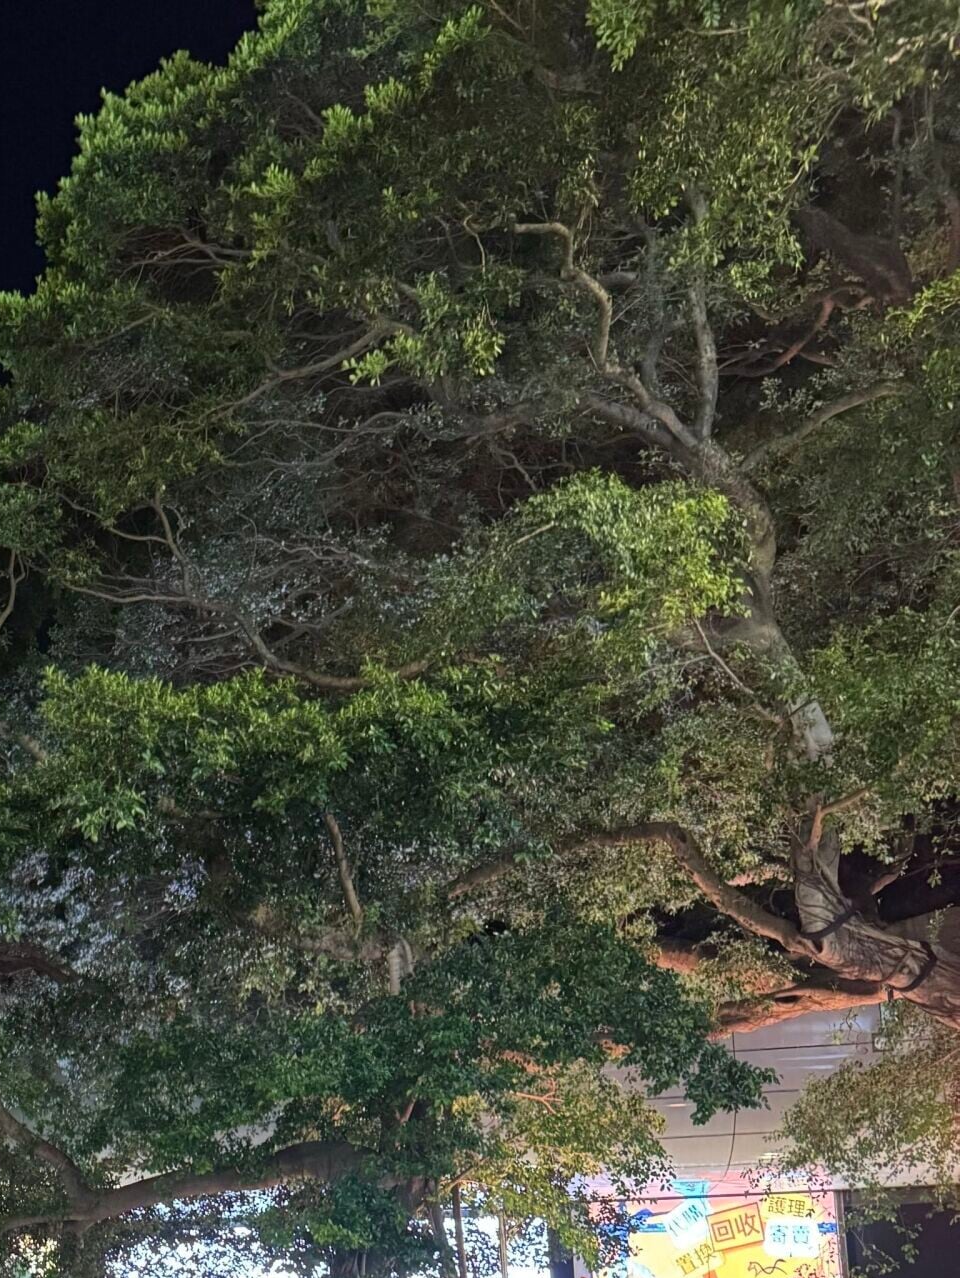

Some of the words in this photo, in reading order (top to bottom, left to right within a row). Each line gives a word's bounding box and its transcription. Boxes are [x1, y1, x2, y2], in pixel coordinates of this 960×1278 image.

[768, 1196, 805, 1218] 護理
[711, 1212, 761, 1243] 回收
[675, 1241, 717, 1276] 置換
